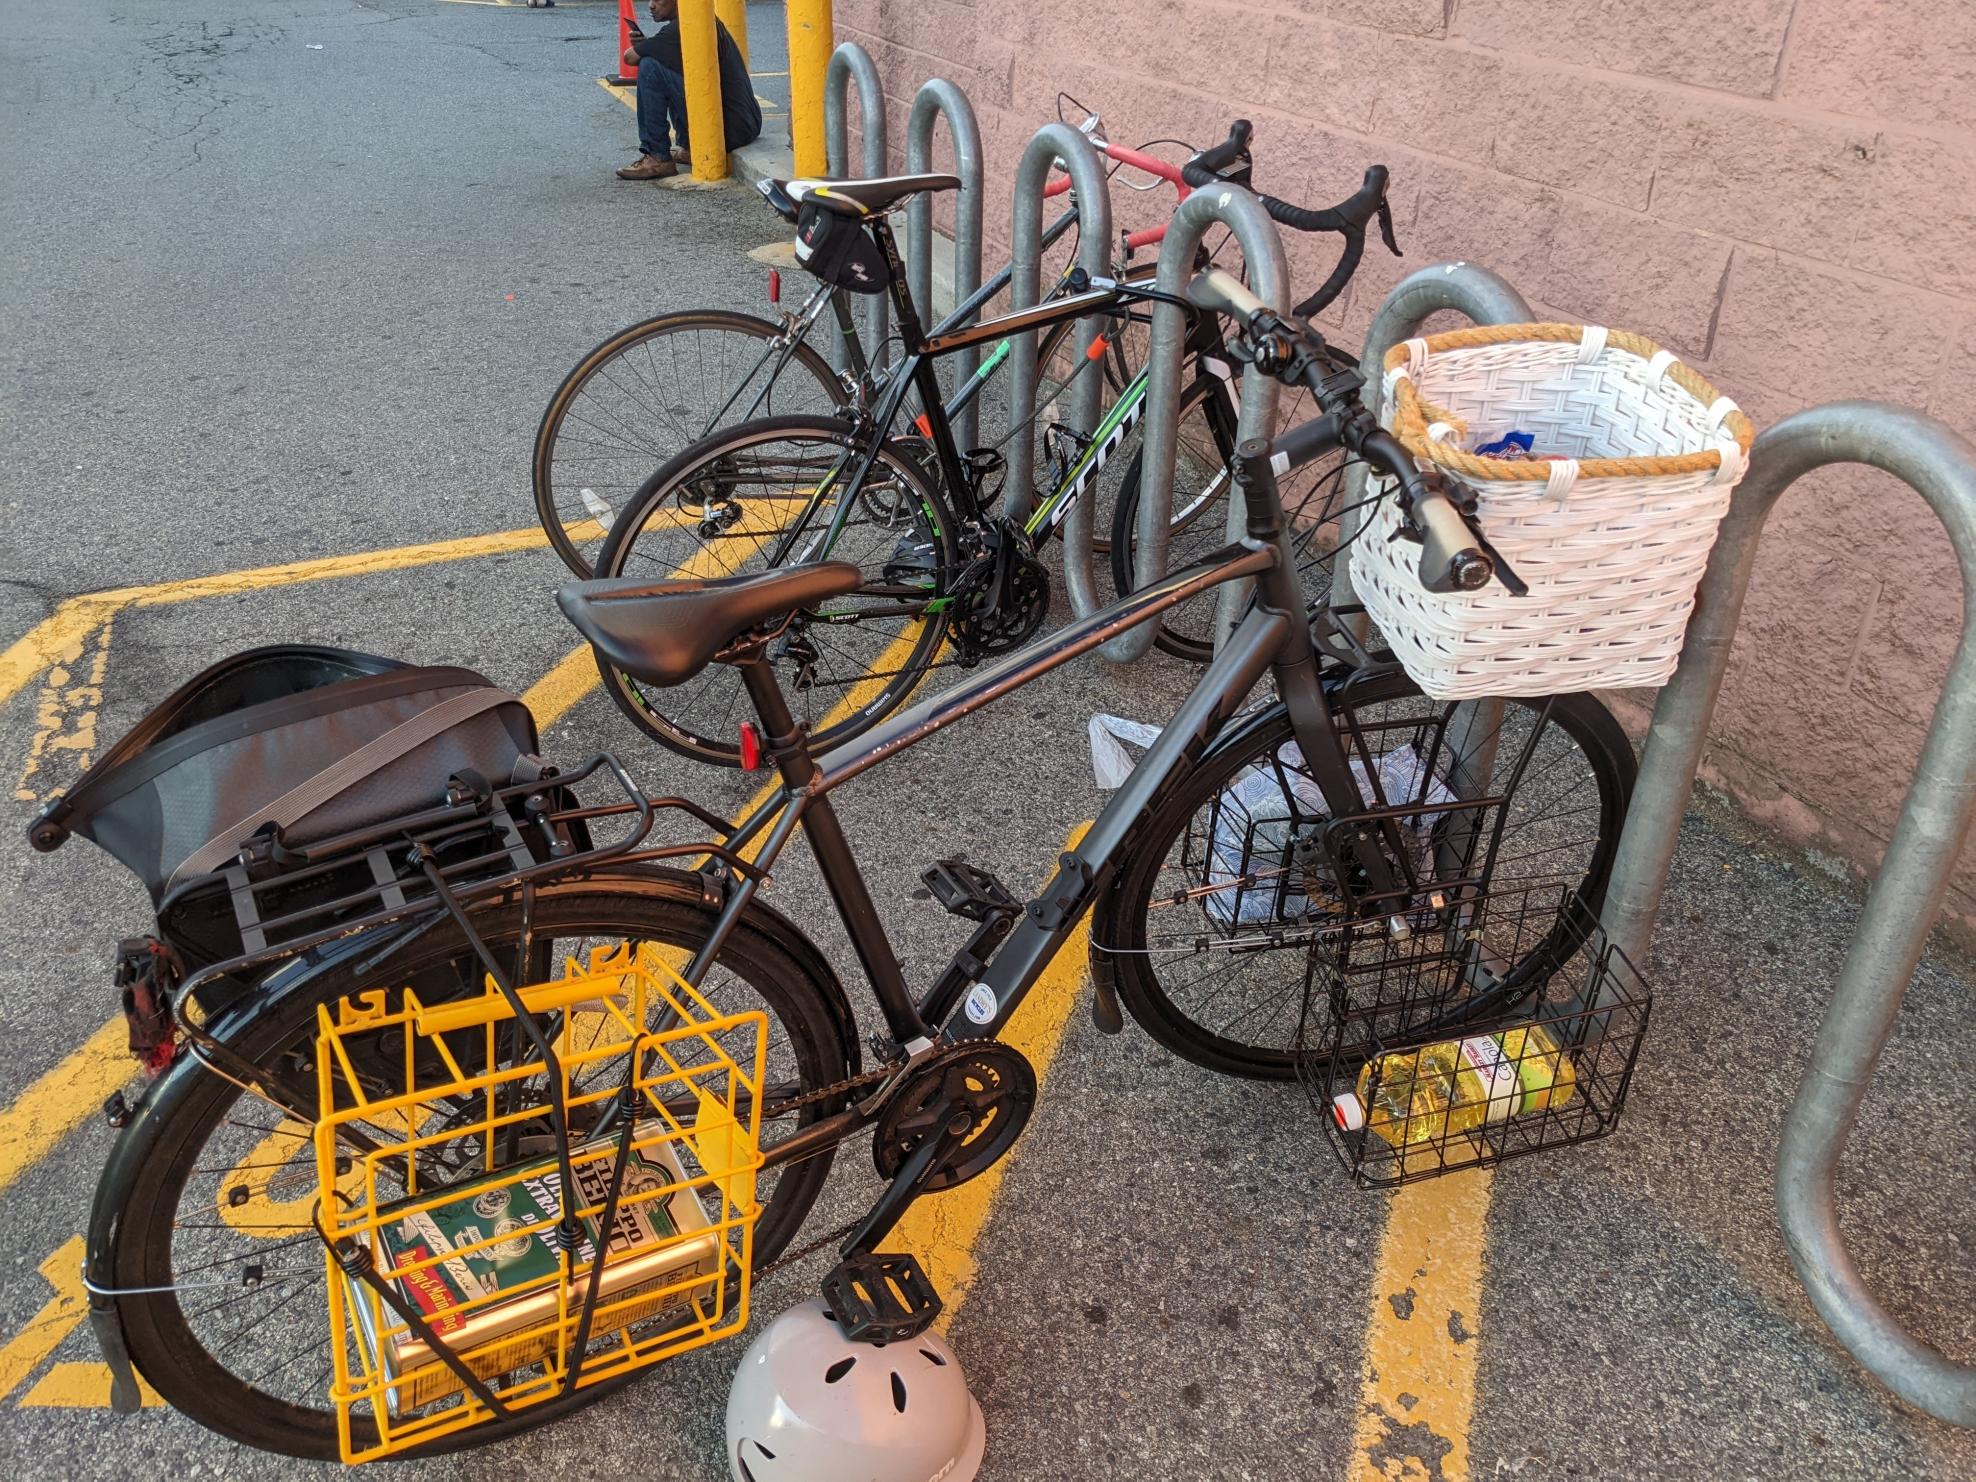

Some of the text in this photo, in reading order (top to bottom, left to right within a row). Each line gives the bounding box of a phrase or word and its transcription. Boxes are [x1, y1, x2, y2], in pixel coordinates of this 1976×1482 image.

[1051, 391, 1146, 527] SCOT
[865, 692, 891, 716] SHIMANO
[1477, 1058, 1490, 1078] MARET
[593, 1154, 644, 1243] FILPO
[398, 1248, 428, 1285] Dreing
[425, 1283, 458, 1332] Marining
